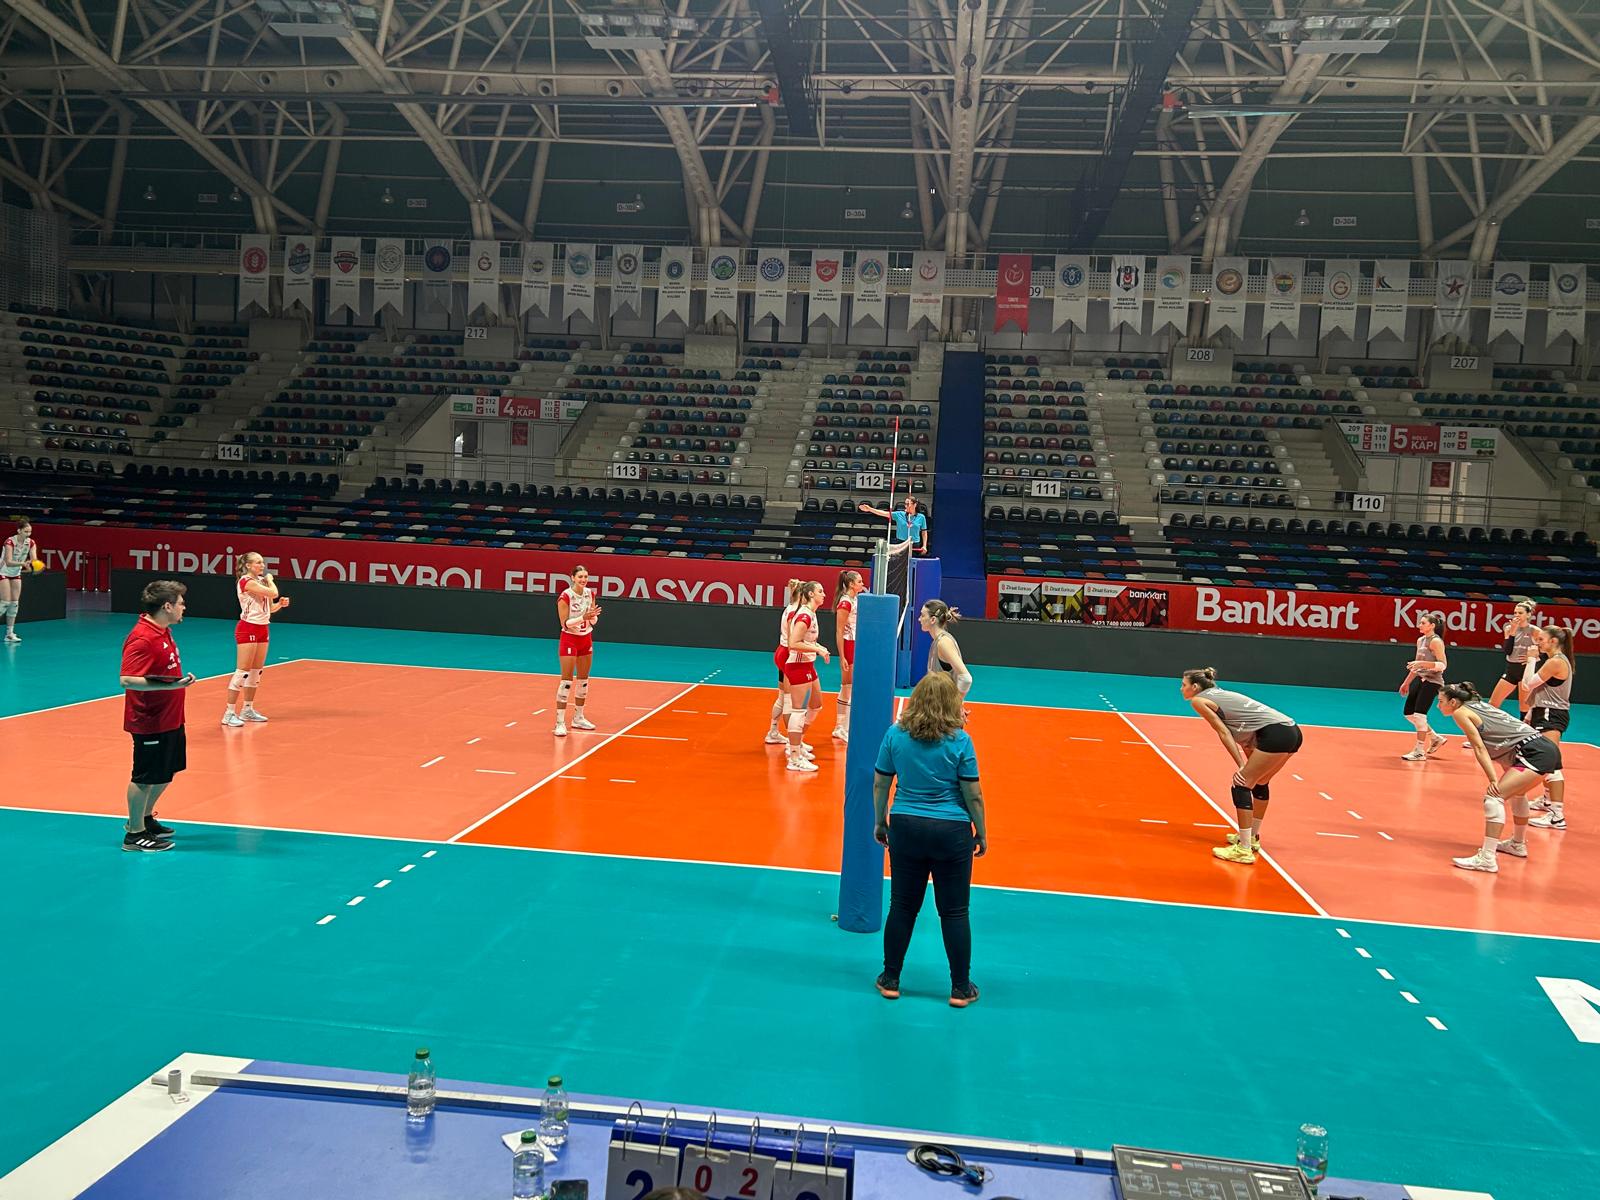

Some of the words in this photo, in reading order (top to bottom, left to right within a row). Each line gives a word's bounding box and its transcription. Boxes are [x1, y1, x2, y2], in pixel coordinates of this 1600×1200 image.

[467, 328, 485, 338] 212
[1189, 350, 1210, 361] 208
[1453, 357, 1476, 368] 207
[503, 399, 515, 416] 4
[517, 409, 536, 417] KAPI
[1393, 428, 1408, 449] 5
[1411, 441, 1438, 450] KAPI
[220, 446, 240, 458] 114
[616, 465, 637, 477] 113
[860, 475, 881, 487] 112
[1036, 483, 1057, 495] 111
[1356, 496, 1381, 510] 110
[129, 543, 280, 576] TÜRKİE
[1195, 586, 1360, 631] Bankkart
[694, 1165, 712, 1193] 0
[739, 1167, 759, 1197] 2
